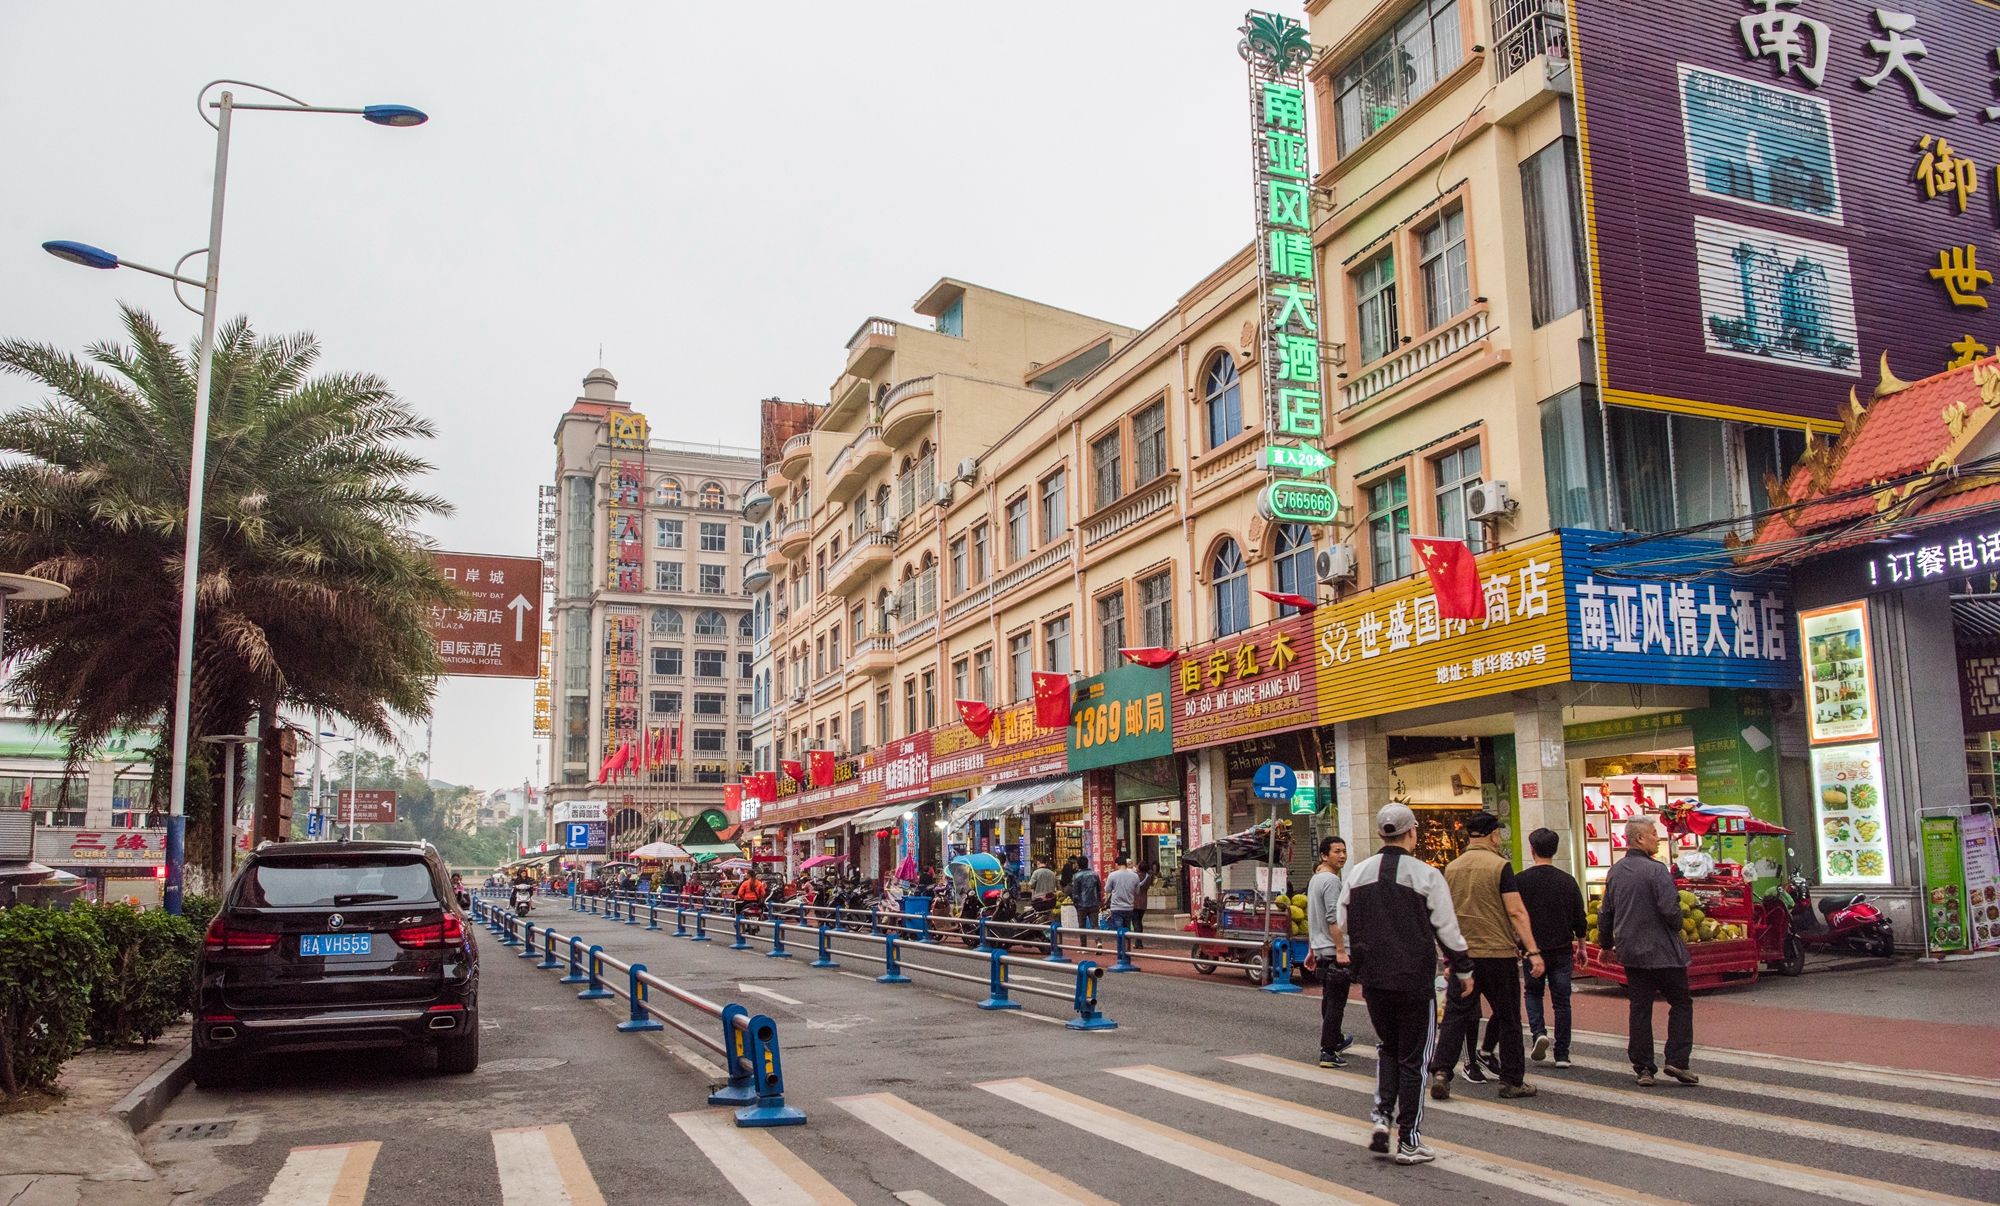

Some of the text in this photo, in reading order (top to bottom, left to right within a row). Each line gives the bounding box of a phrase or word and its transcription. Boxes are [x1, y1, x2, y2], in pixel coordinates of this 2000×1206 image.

[1740, 0, 2000, 120] 南天
[1262, 80, 1322, 437] 南亚风情大酒店
[1272, 448, 1326, 467] 直入20米
[1284, 490, 1331, 512] 7665666
[443, 567, 505, 585] 口岸城
[1575, 576, 1786, 660] 南亚风情大酒店
[439, 656, 503, 666] NATIONAL HOTEL
[1259, 678, 1283, 700] HANG
[1075, 700, 1121, 750] 1369
[1125, 691, 1165, 737] 邮局
[1269, 764, 1287, 787] P
[571, 825, 586, 841] P
[399, 916, 422, 924] X5
